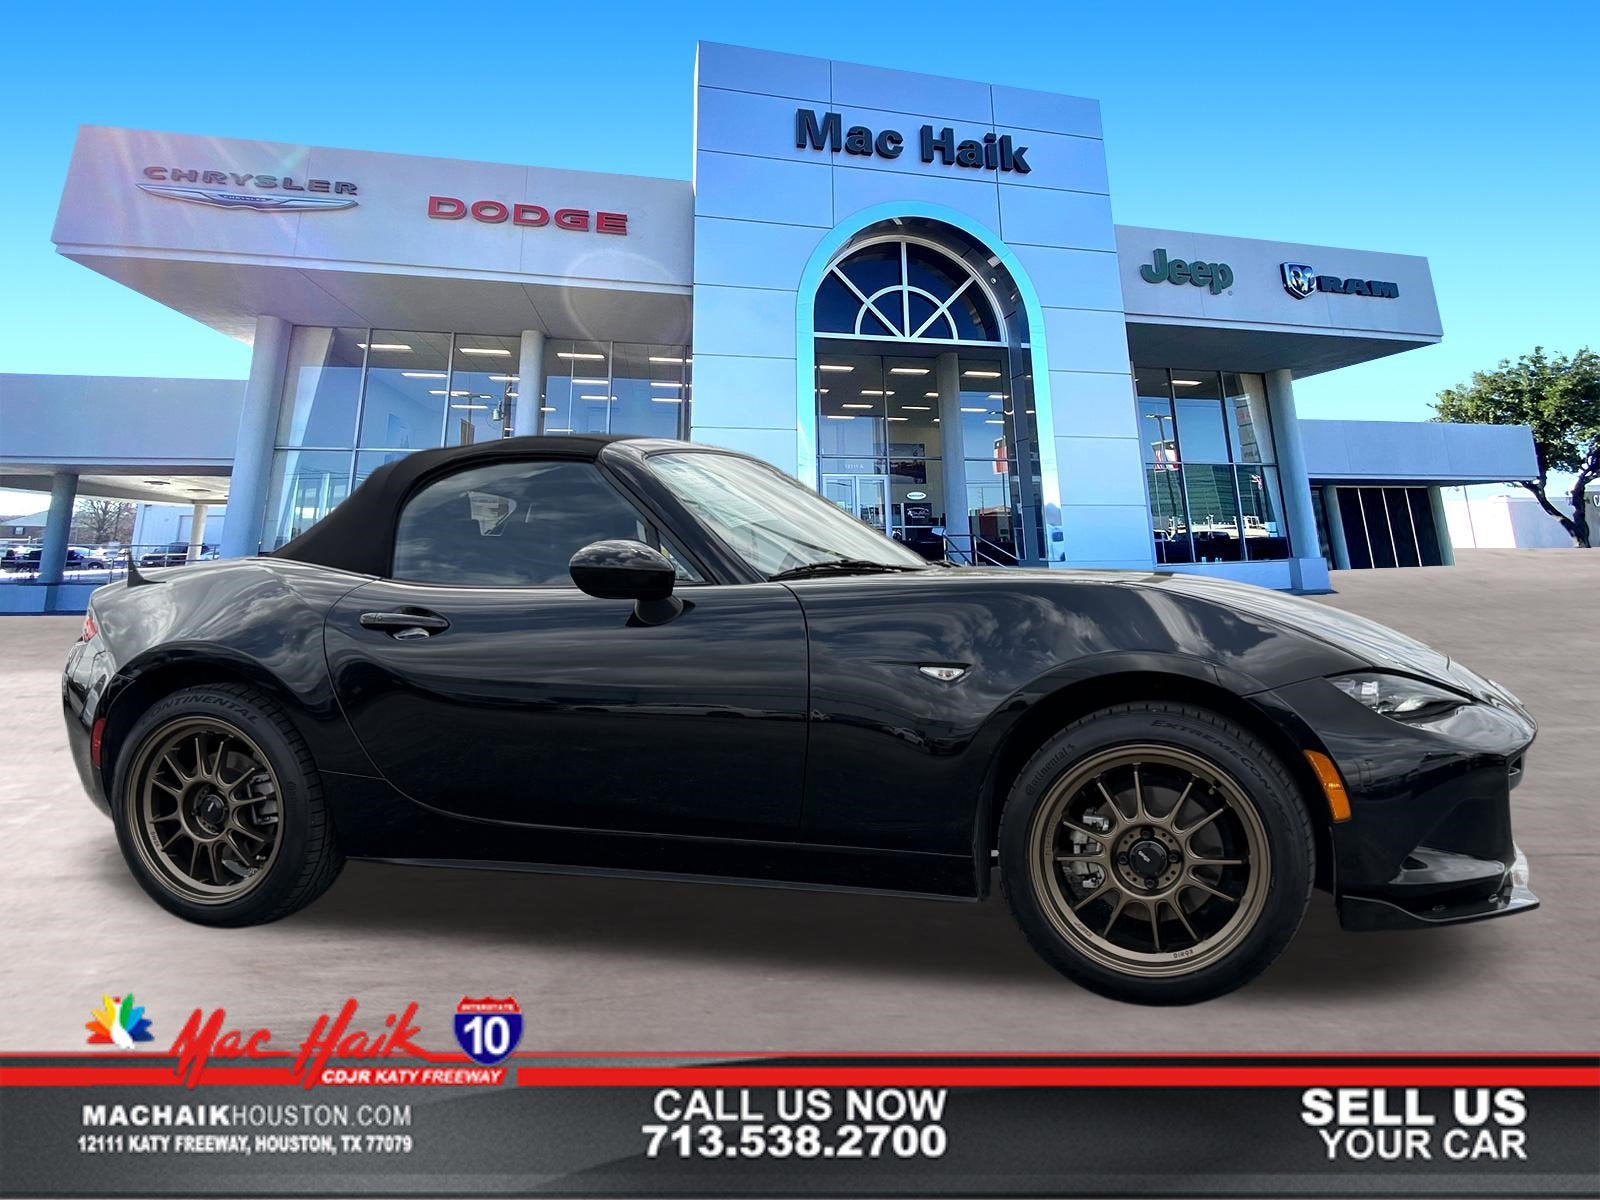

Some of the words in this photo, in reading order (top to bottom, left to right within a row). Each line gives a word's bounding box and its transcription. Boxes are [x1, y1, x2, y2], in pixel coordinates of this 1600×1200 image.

[795, 108, 904, 160] Mac
[919, 124, 1032, 175] Haik
[142, 165, 359, 196] CHRYSLER
[427, 195, 629, 236] DODGE
[1138, 247, 1235, 297] Jeep
[1315, 274, 1400, 299] RAM
